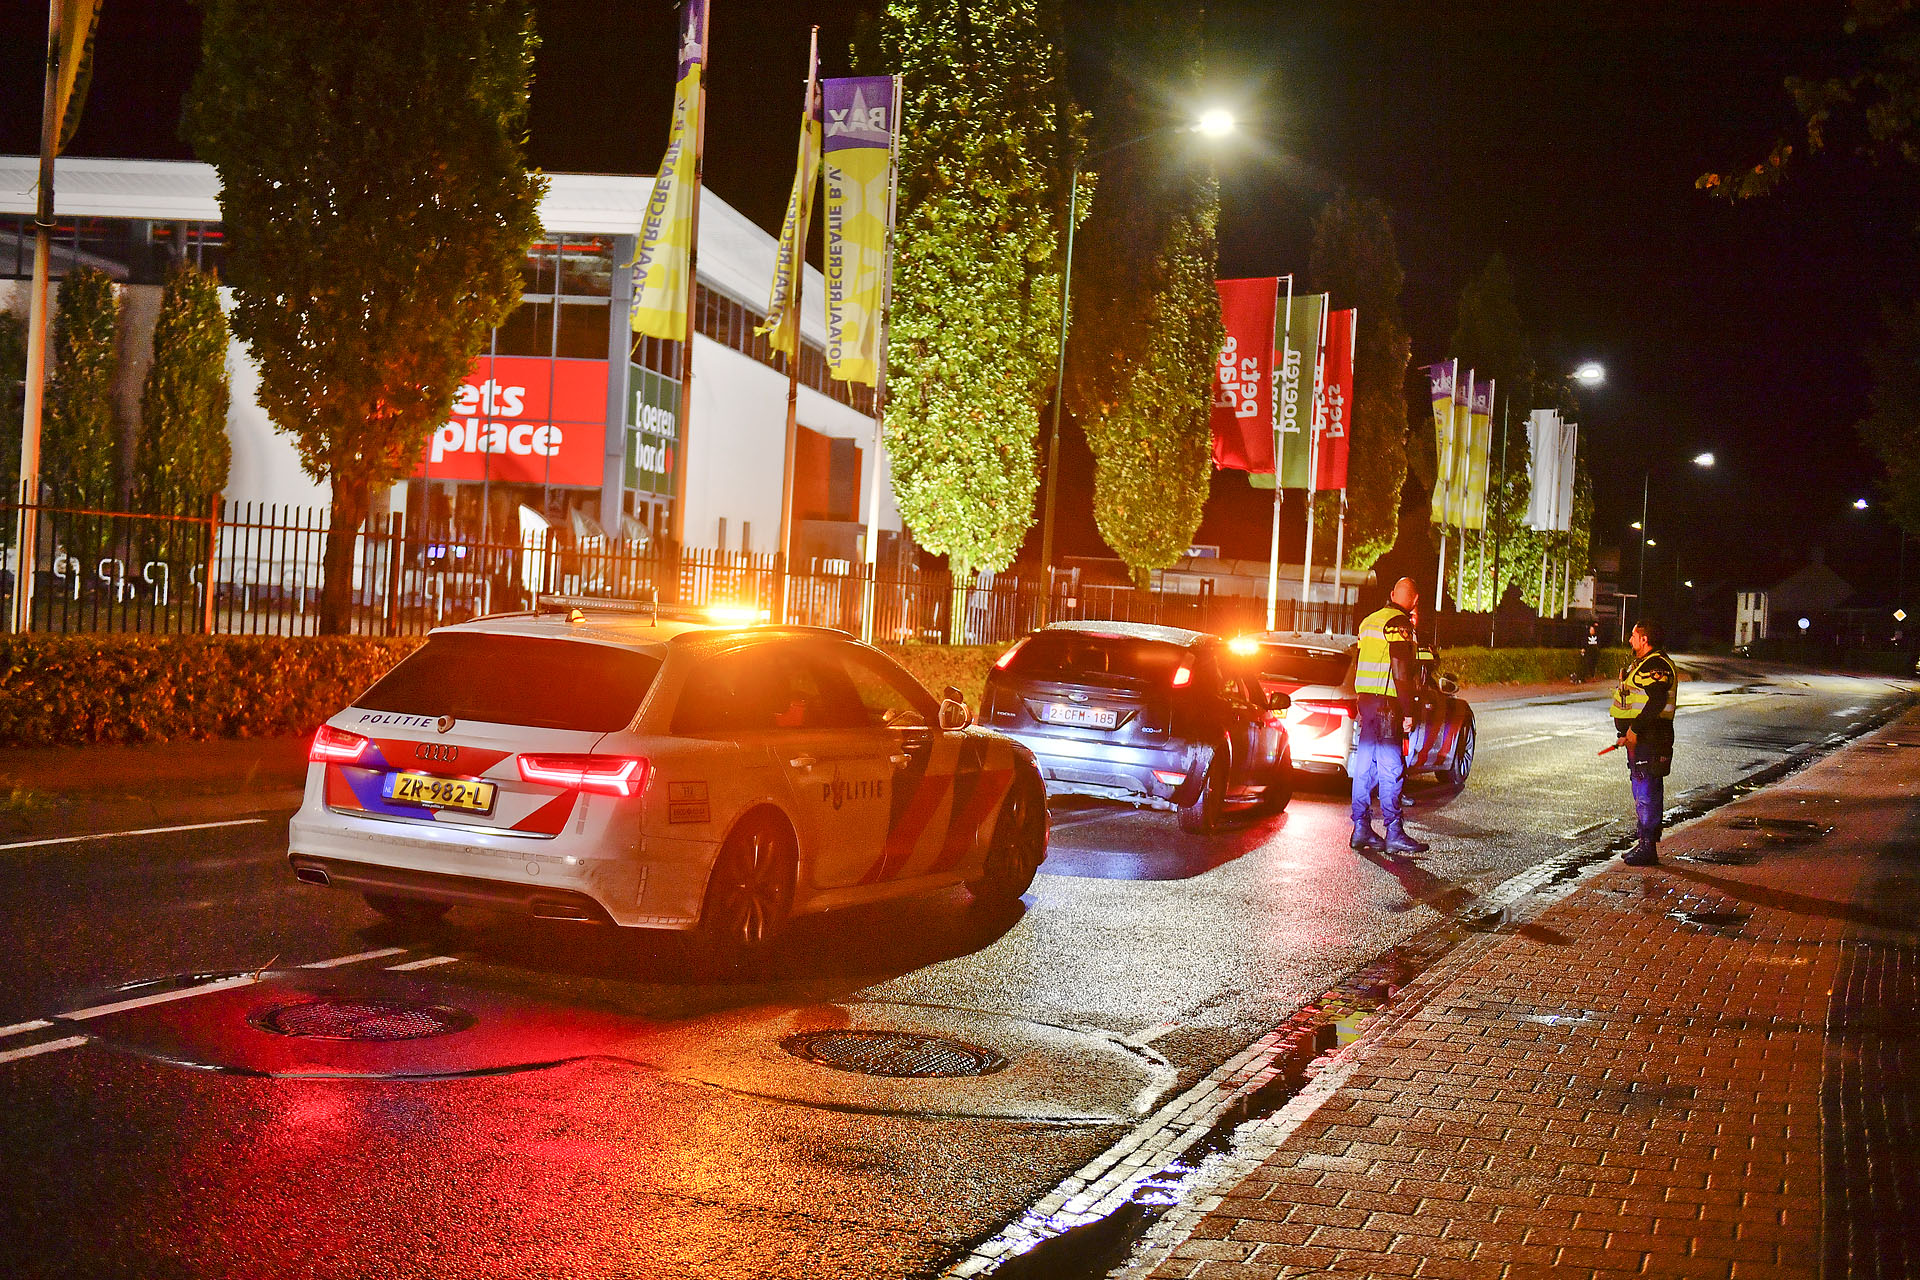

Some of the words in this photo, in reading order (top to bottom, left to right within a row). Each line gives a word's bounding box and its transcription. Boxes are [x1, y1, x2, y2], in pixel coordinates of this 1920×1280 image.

[450, 378, 526, 417] ets
[635, 390, 676, 437] boeren
[430, 417, 563, 463] place
[635, 431, 667, 474] bond
[359, 714, 433, 728] POLITIE
[399, 777, 483, 806] ZR-982-L
